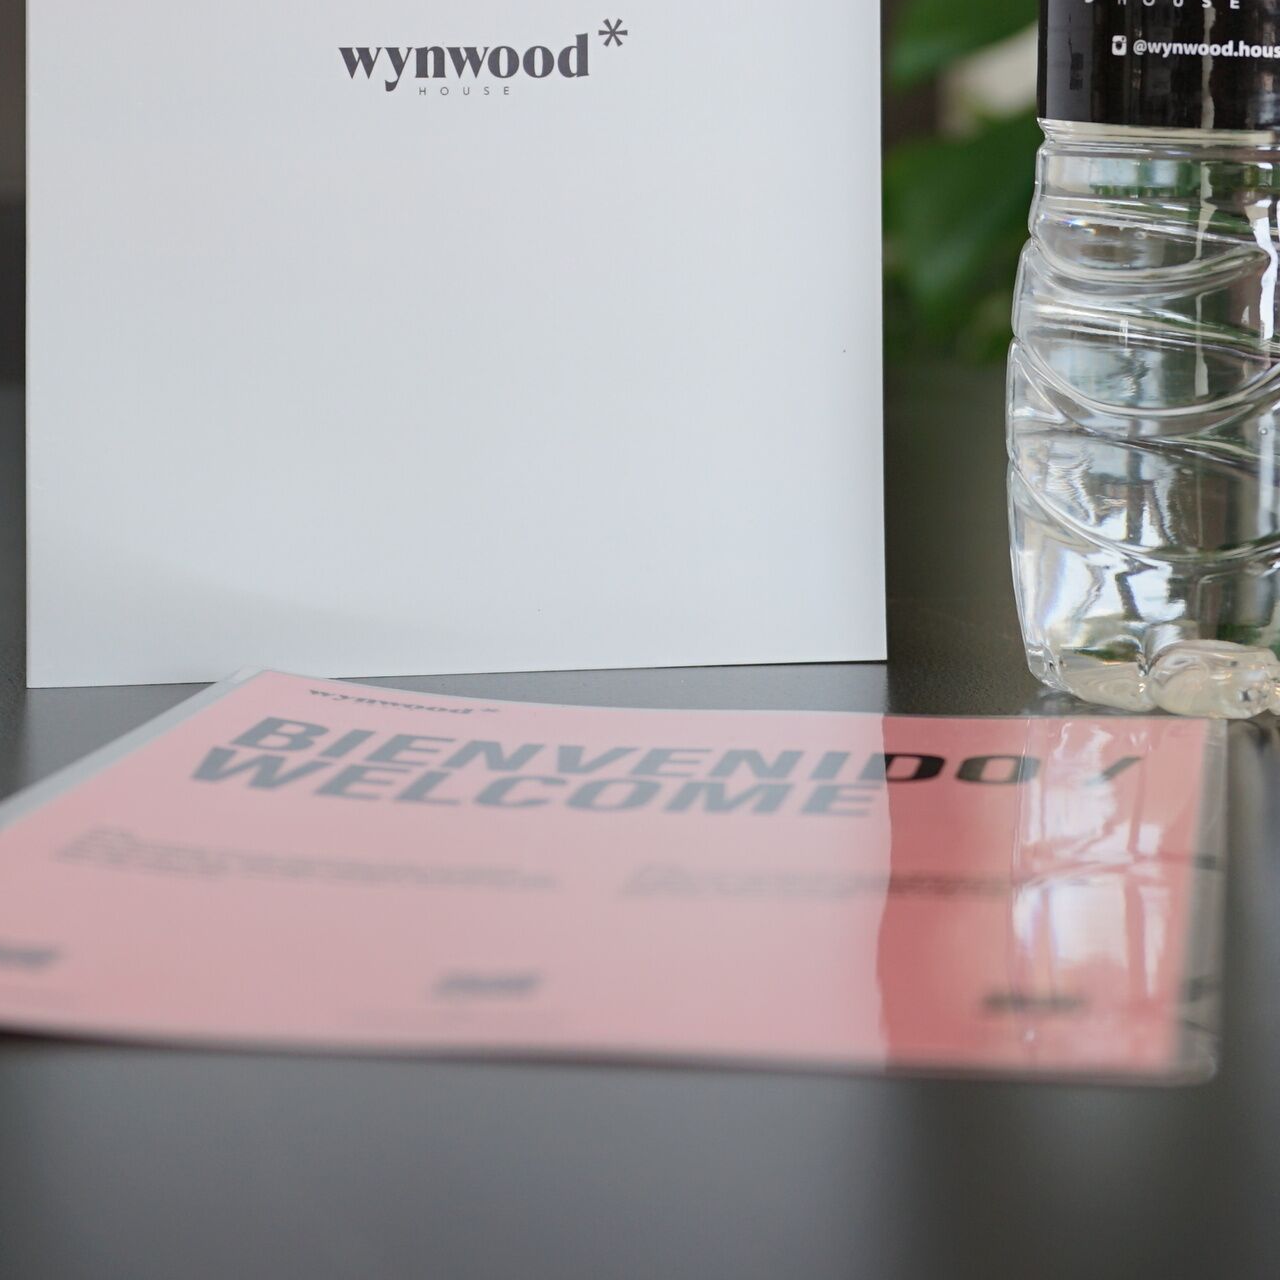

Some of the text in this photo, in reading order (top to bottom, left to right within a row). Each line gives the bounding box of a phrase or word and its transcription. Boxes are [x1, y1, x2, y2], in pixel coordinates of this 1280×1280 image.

[418, 86, 510, 97] HOUSE
[189, 746, 884, 818] WELCOME
[227, 716, 1040, 785] BIENVENIDO
